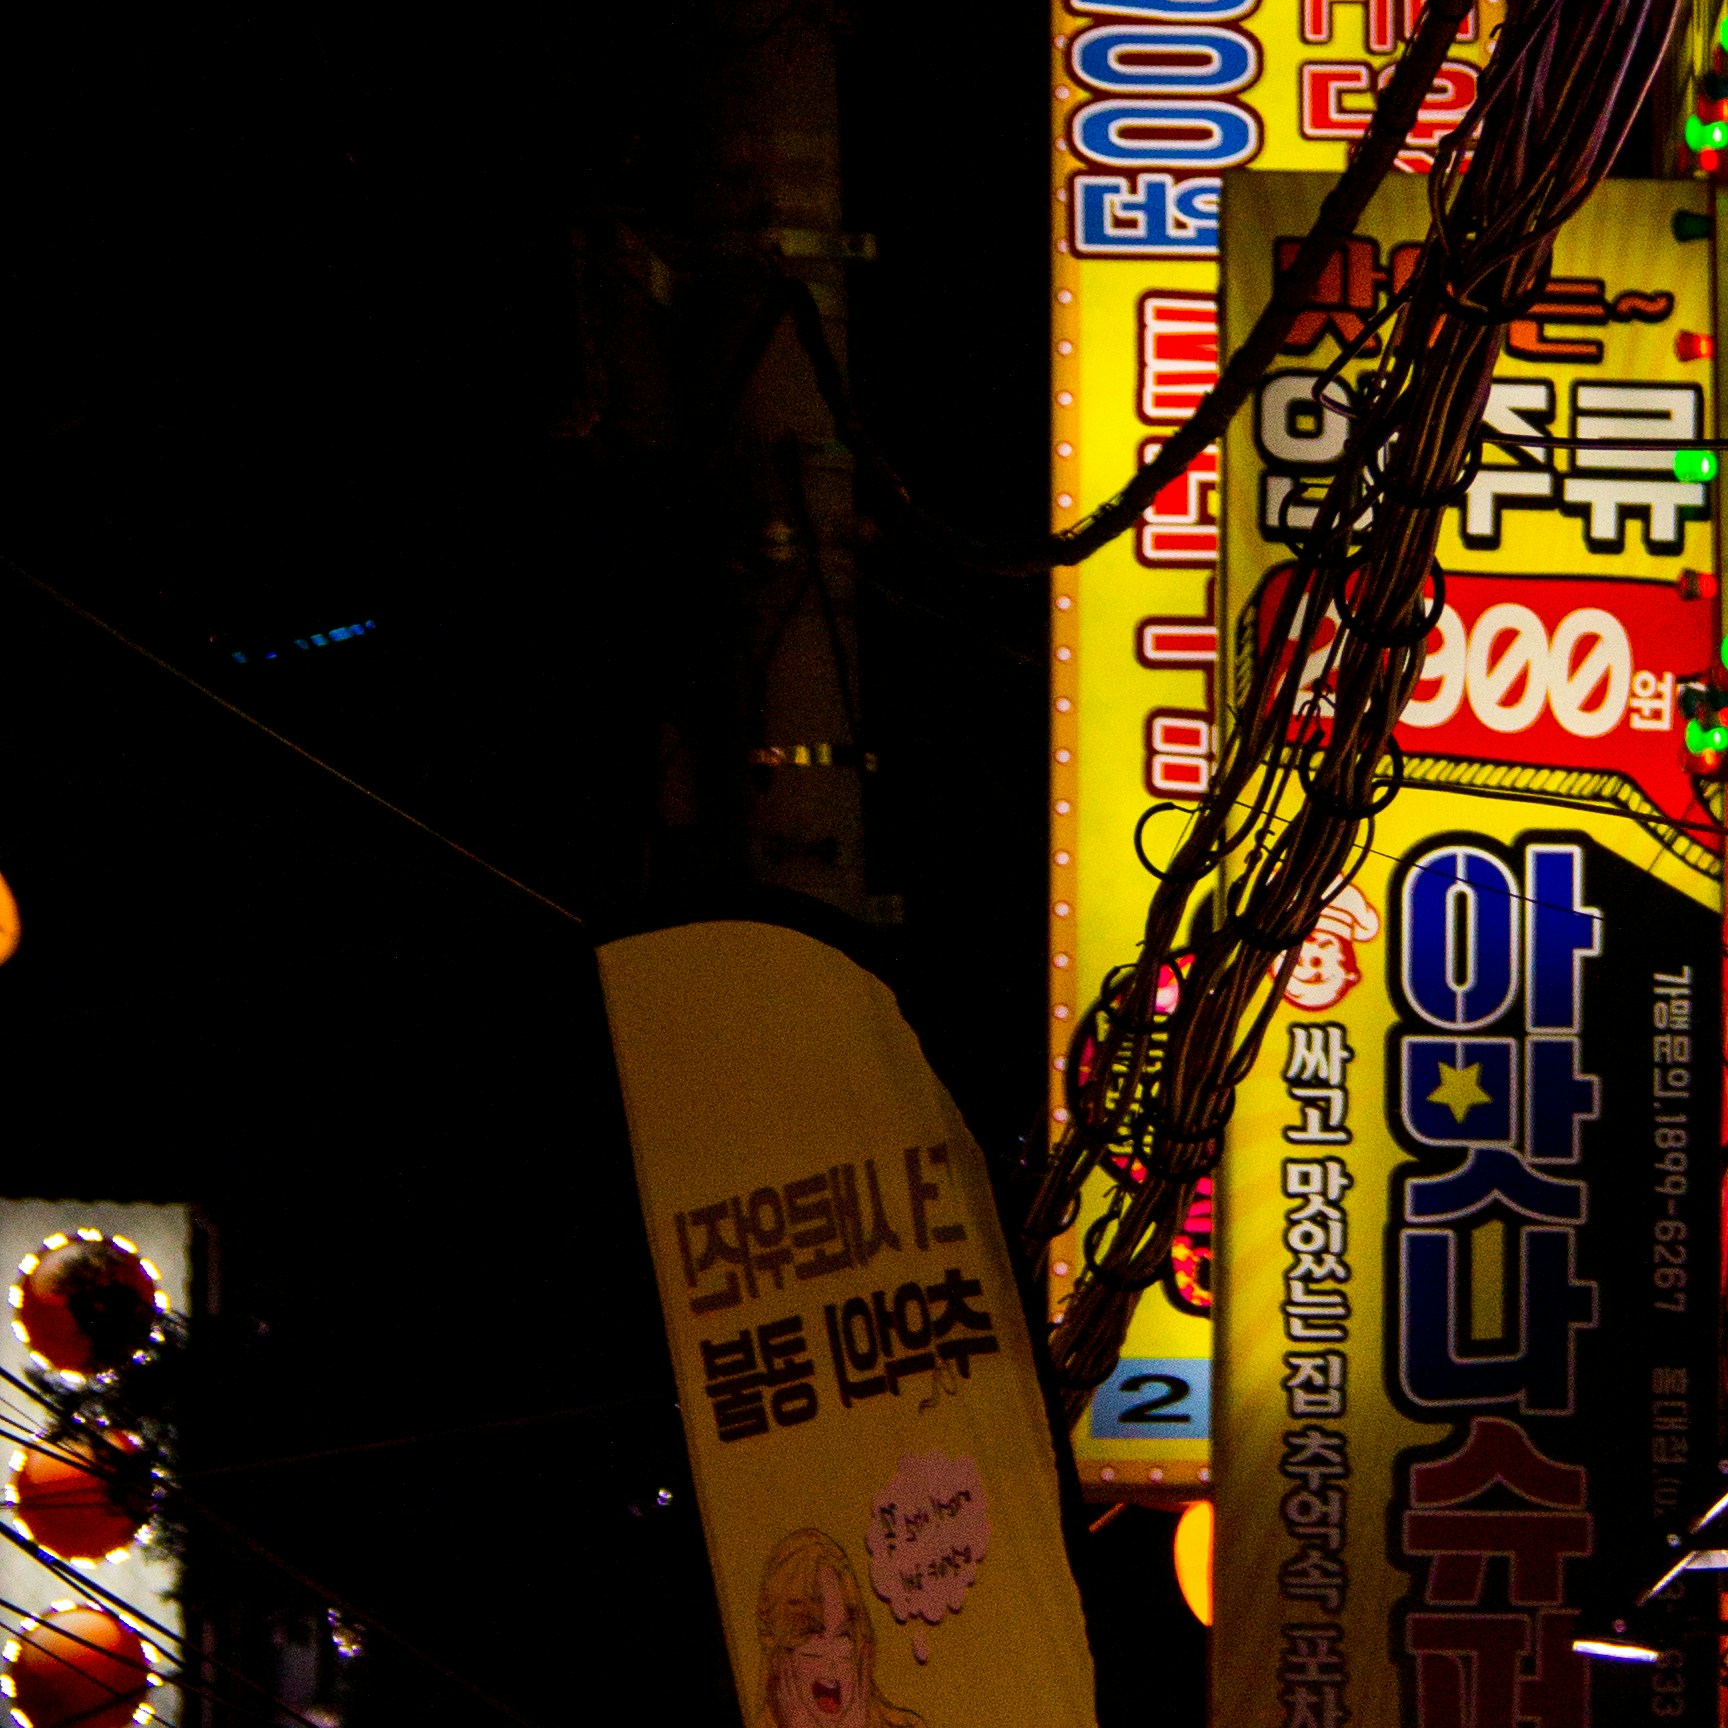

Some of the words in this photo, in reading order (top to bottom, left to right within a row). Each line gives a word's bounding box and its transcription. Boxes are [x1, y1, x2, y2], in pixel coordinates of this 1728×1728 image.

[1284, 1023, 1354, 1144] 싸고
[1283, 1155, 1354, 1342] 맛있는
[1282, 1349, 1346, 1419] 집
